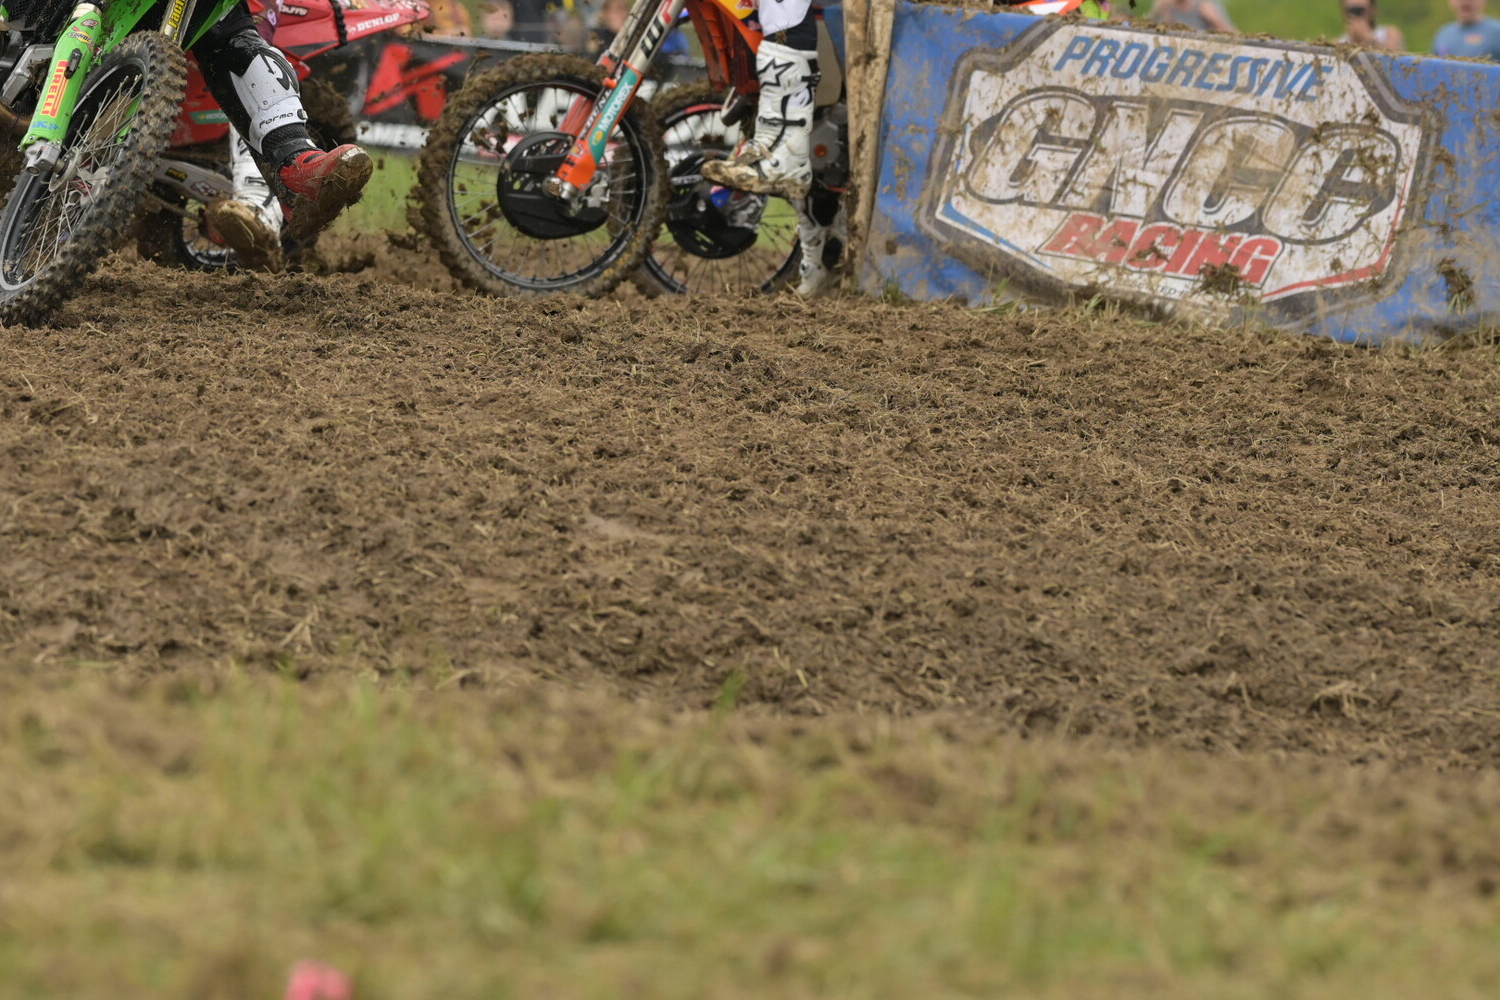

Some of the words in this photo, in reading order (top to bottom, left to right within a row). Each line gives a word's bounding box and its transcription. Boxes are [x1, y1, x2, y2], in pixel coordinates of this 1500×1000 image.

[357, 13, 400, 33] DUNLOP
[1054, 34, 1332, 102] PROGRESSIVE
[599, 81, 634, 133] MOTOREX
[965, 88, 1401, 245] GNCC
[1044, 212, 1285, 284] RACING
